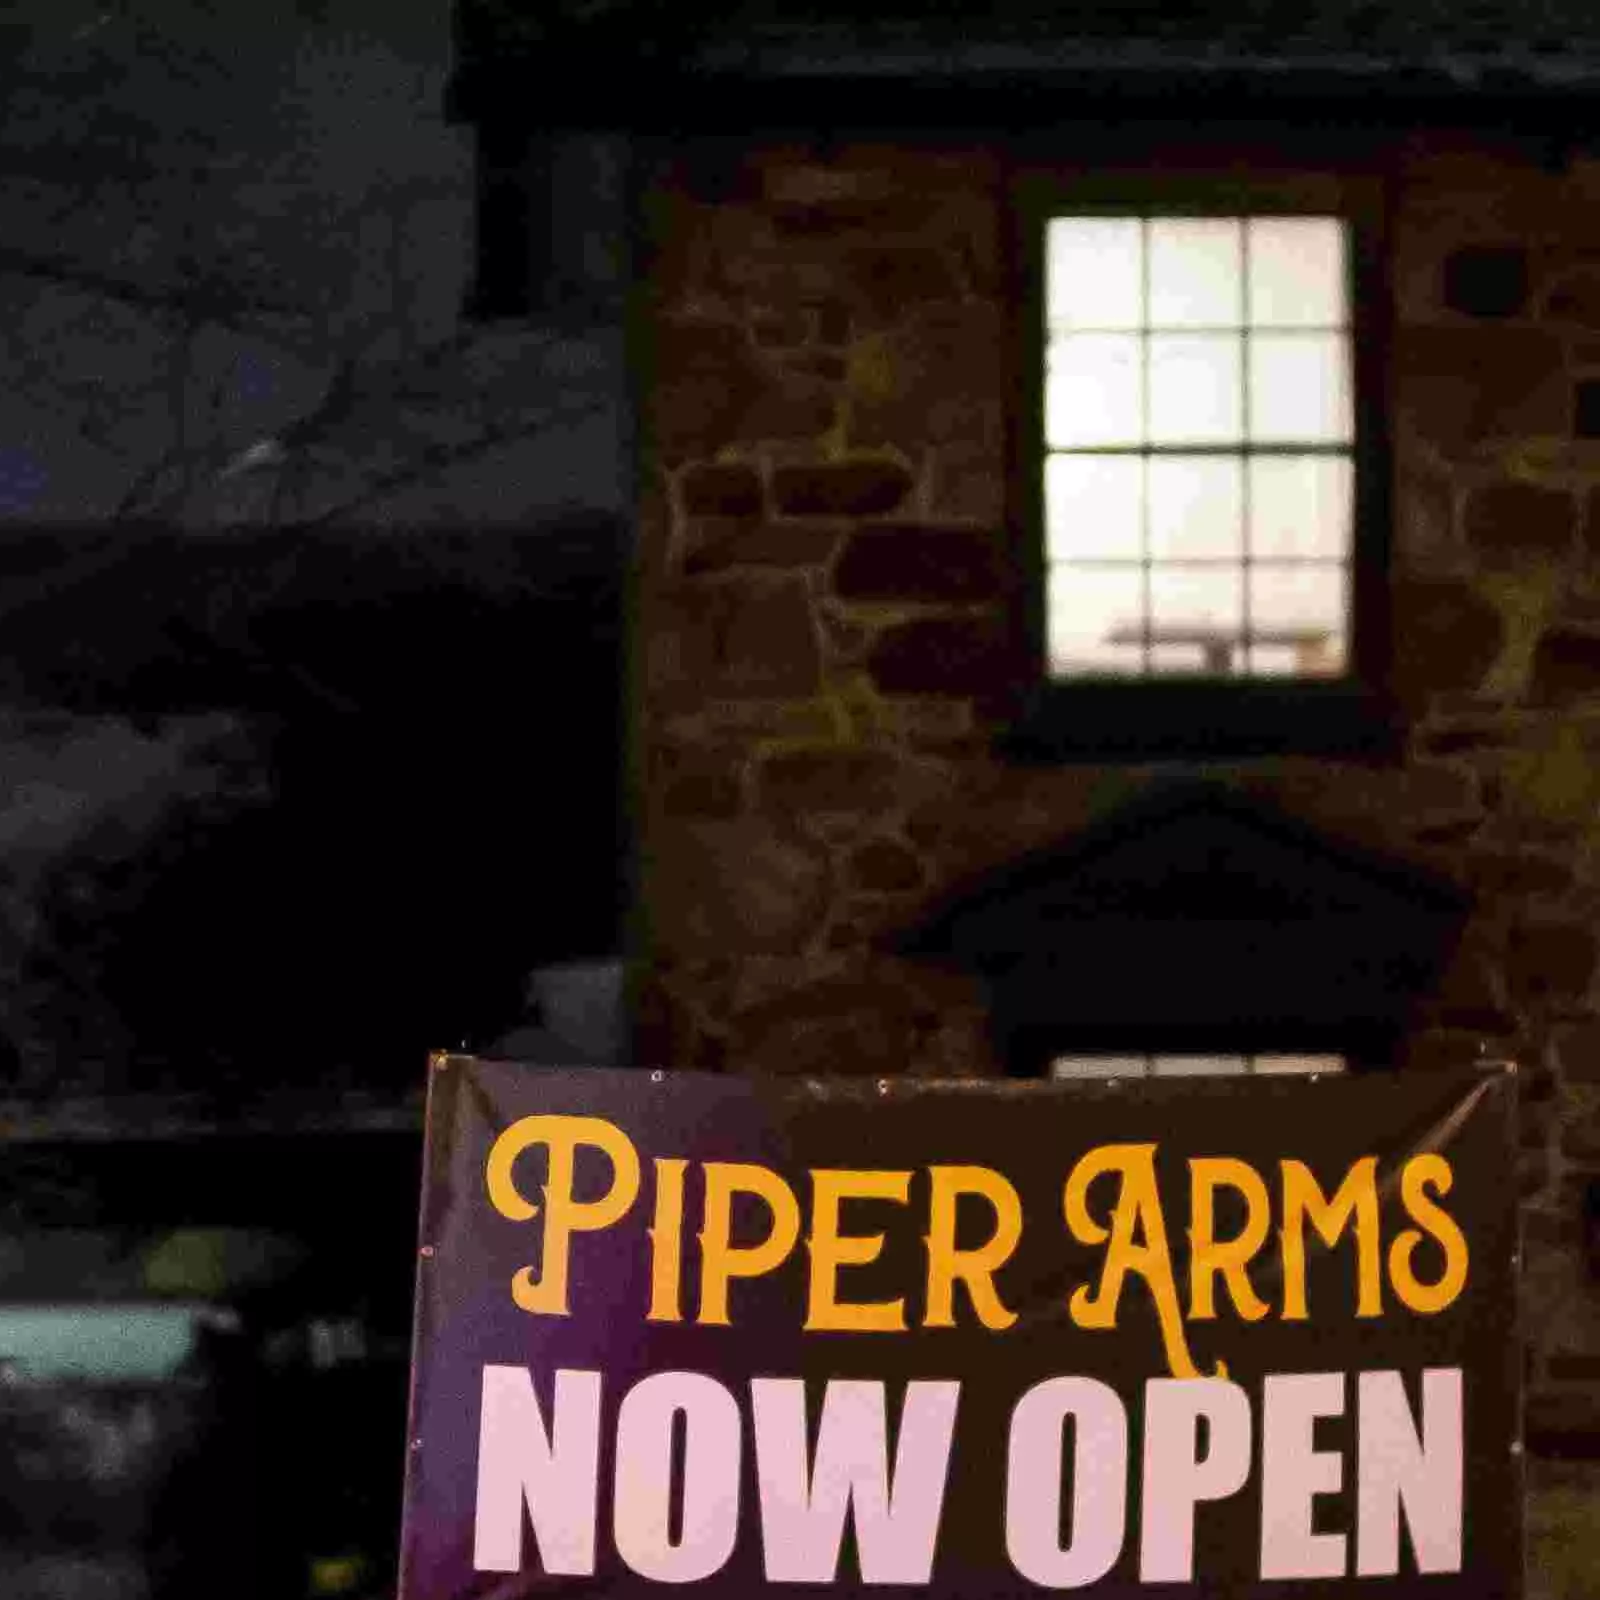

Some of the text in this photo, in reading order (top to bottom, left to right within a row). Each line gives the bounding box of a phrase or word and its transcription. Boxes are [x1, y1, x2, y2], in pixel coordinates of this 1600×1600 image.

[486, 1114, 1468, 1382] PIPER ARMS
[473, 1364, 1463, 1588] NOW OPEN
